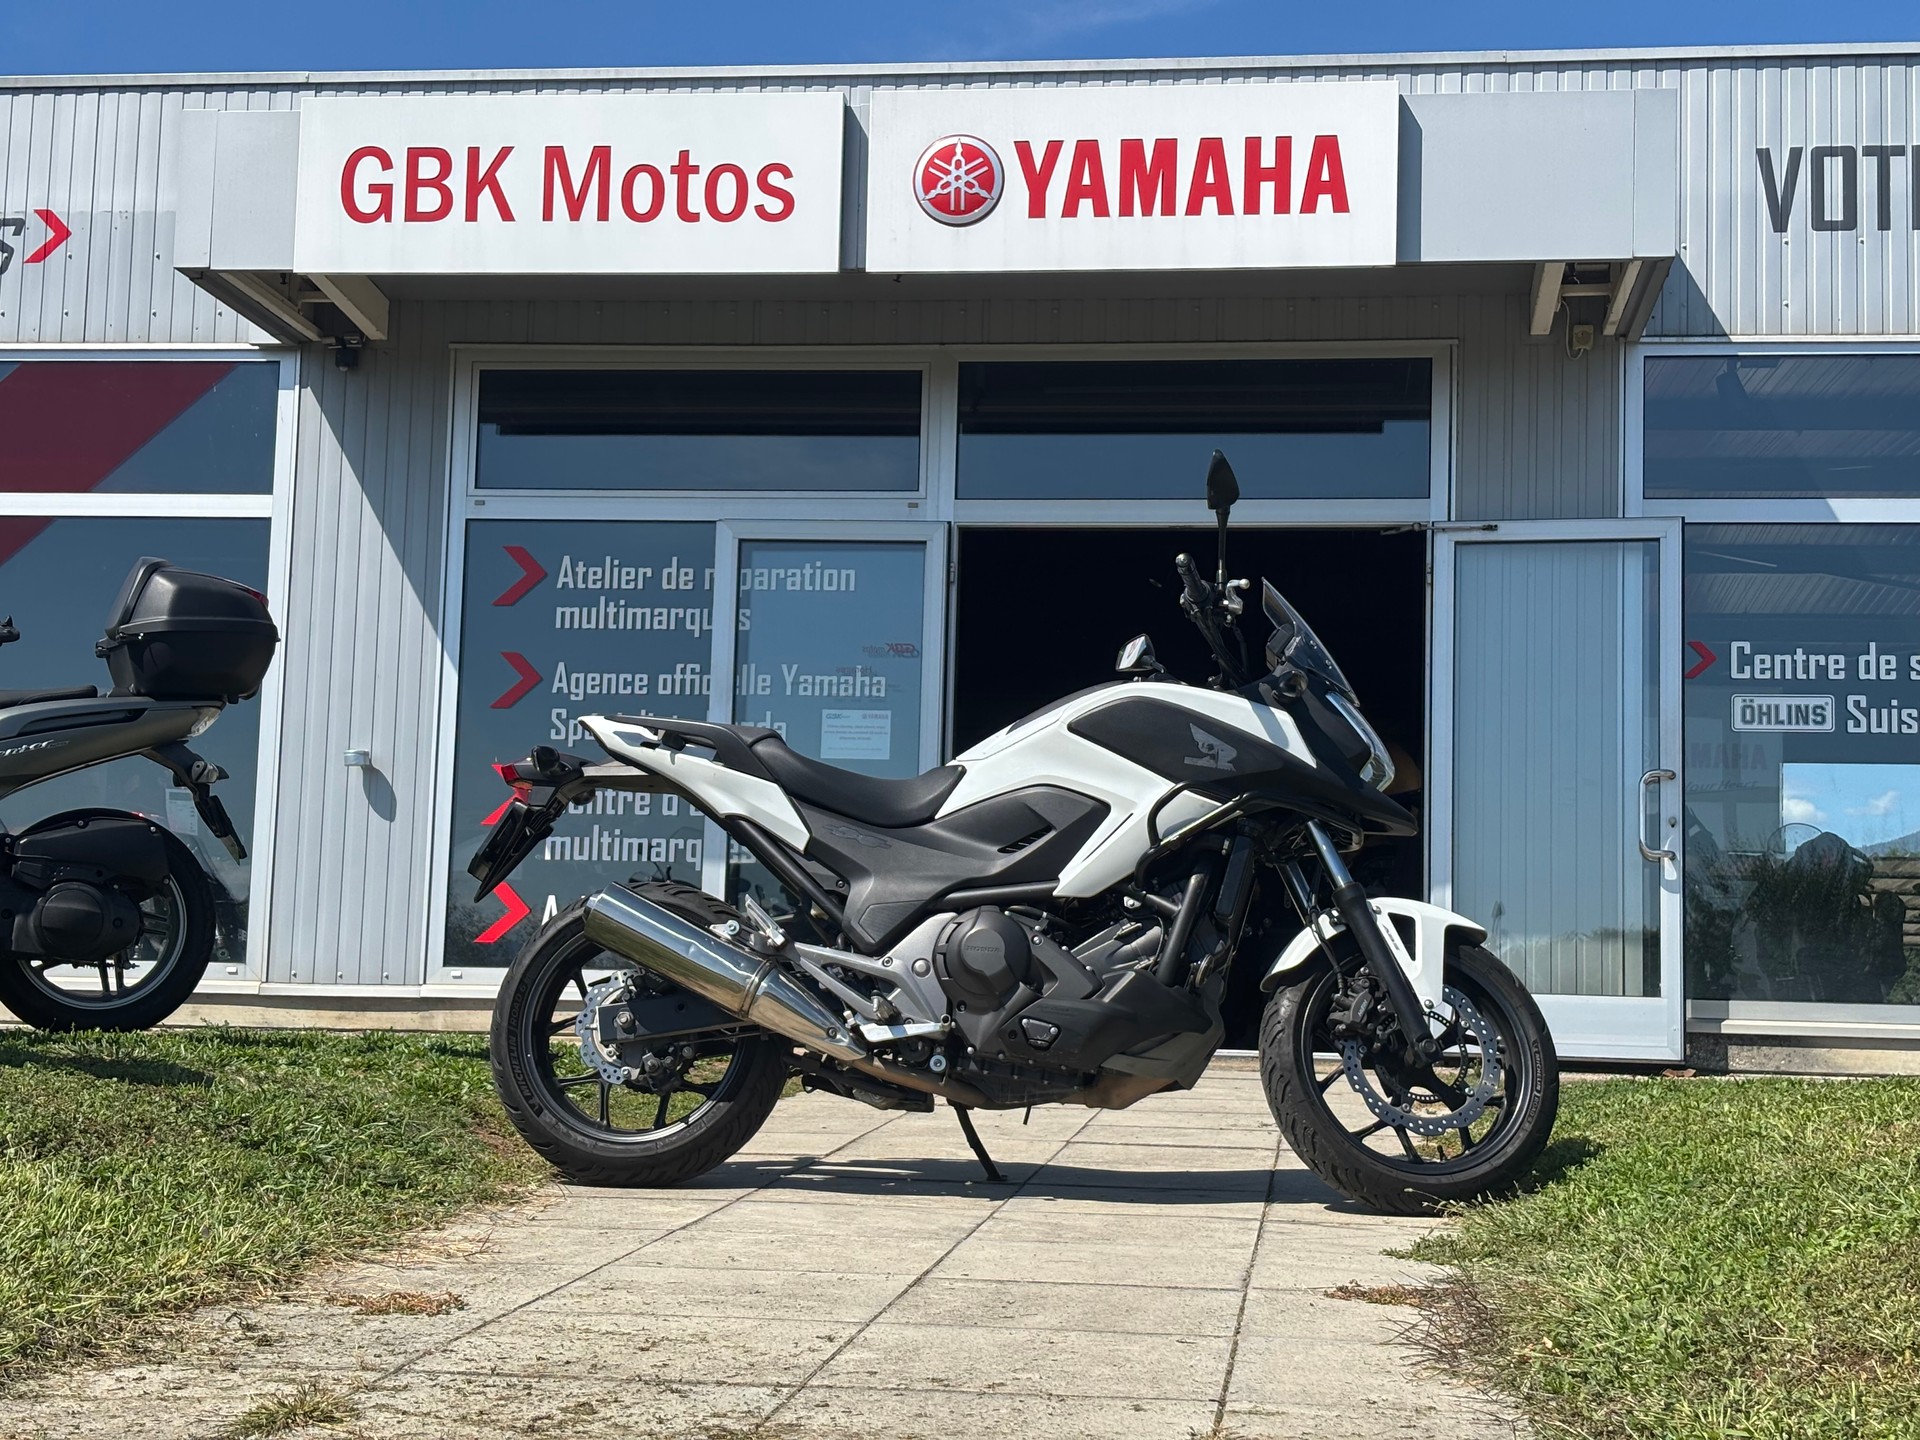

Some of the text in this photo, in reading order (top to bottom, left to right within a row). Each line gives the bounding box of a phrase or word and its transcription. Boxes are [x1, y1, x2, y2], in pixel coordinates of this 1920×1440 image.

[341, 145, 796, 223] GBK Motos
[1013, 135, 1350, 219] YAMAHA
[1756, 145, 1920, 233] VOT
[556, 555, 856, 598] Atelier de rparation
[555, 595, 751, 638] multimarqus
[551, 661, 886, 701] Agence officlle Yamaha
[1730, 641, 1846, 680] Centre
[1858, 641, 1897, 680] de
[1740, 698, 1827, 726] ÖHLINS
[1691, 743, 1767, 770] MAHA
[562, 788, 650, 816] ntre
[545, 824, 757, 871] multimarqe
[510, 993, 523, 1025] ROAD
[508, 1035, 532, 1098] MICHELIN
